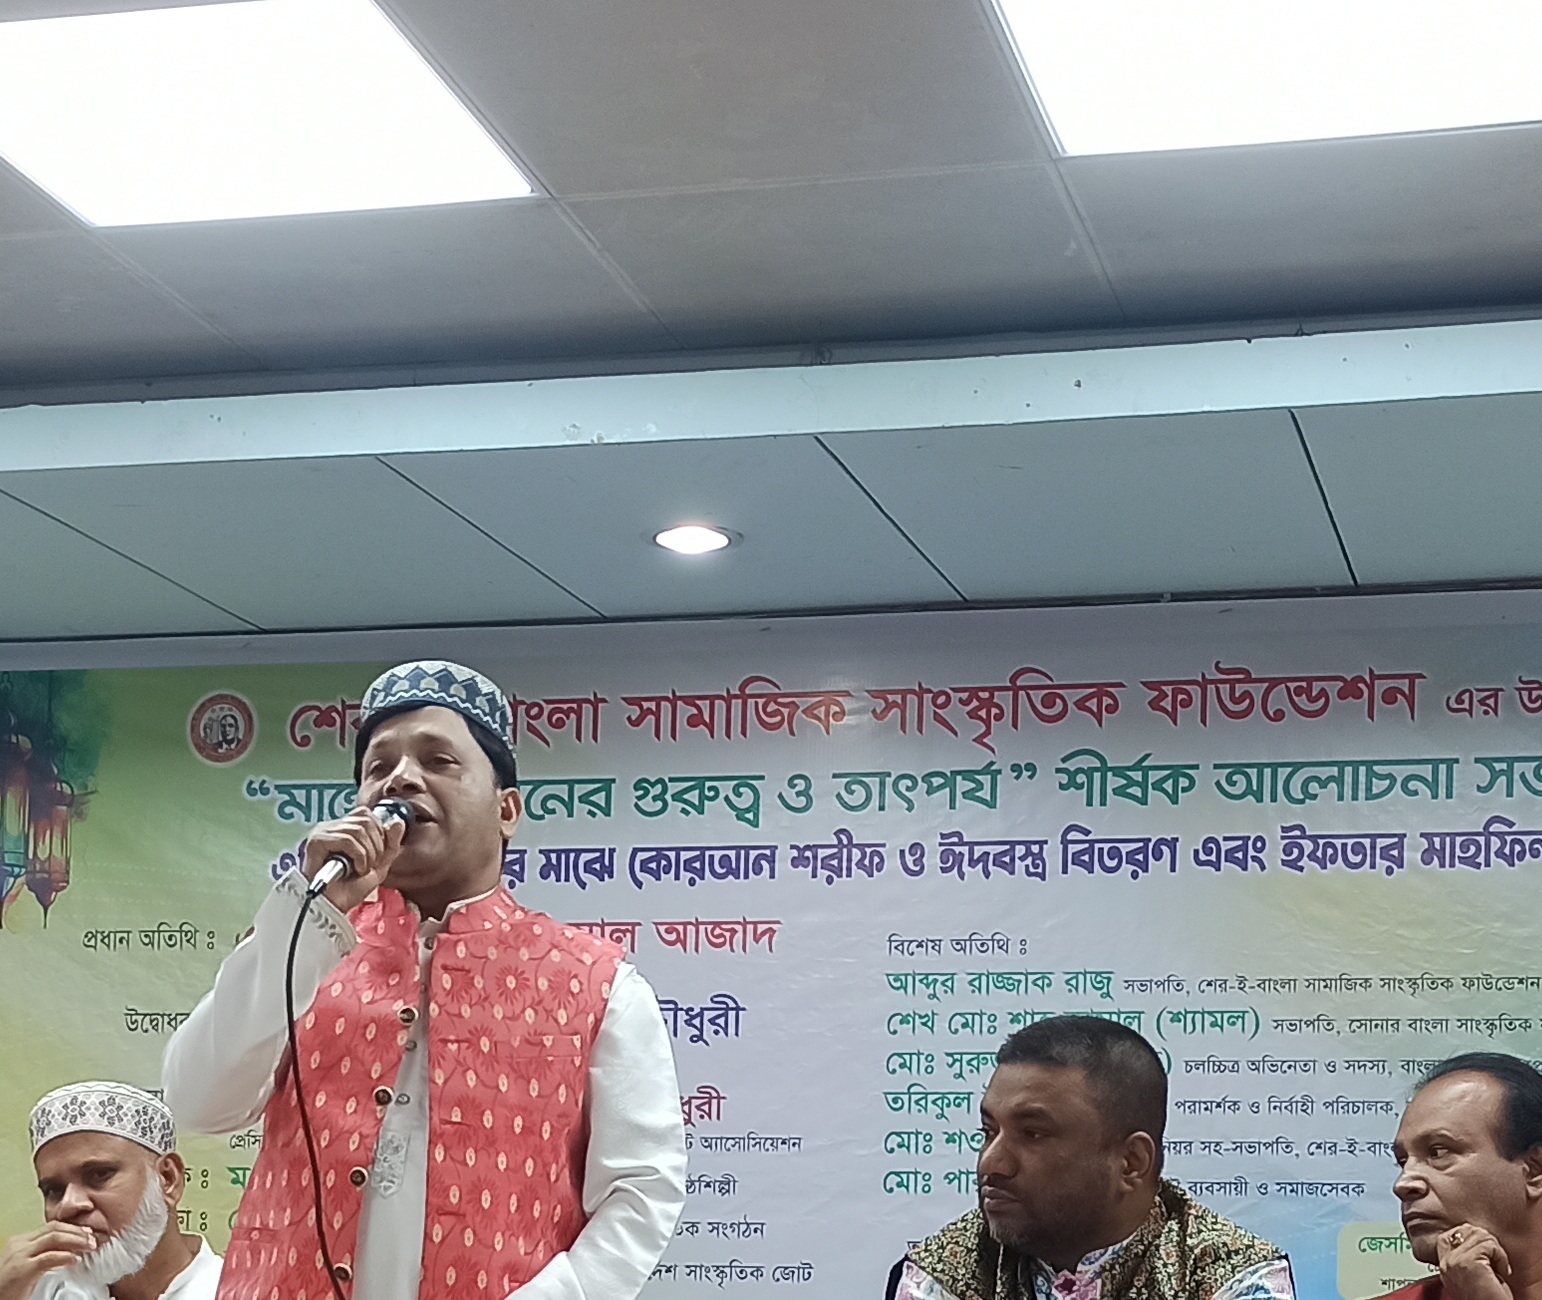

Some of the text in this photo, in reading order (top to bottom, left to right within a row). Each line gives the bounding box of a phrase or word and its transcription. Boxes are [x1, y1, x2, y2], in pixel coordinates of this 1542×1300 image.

[621, 675, 852, 742] সামাজিক
[865, 667, 1126, 754] সাংস্কৃতিক
[1140, 660, 1427, 728] ফাউন্ডেশন
[1445, 687, 1505, 719] এর
[632, 774, 765, 829] গুরুত্ব
[777, 773, 814, 814] ও
[1056, 749, 1200, 809] শীর্ষক
[1213, 757, 1460, 806] আলোচনা
[538, 847, 616, 891] মাঝে
[629, 844, 777, 887] কোরআন
[790, 828, 886, 886] শরীফ
[898, 842, 926, 877] ও
[939, 831, 1048, 882] ঈদবস্ত্র
[1061, 824, 1179, 880] বিতরণ
[1193, 834, 1267, 873] এবং
[1280, 824, 1407, 876] ইফতার
[82, 929, 131, 952] প্রধান
[139, 922, 200, 951] অতিথি
[652, 916, 783, 954] আজাদ
[886, 933, 944, 956] বিশেষ
[950, 932, 1010, 955] অতিথি
[885, 968, 1542, 1003] আব্দুর রাজ্জাক রাজু সভাপতি, শের-ই-বাংলা সামাজিক সাংস্কৃতিক ফাউন্ডেশন
[887, 1009, 939, 1036] শেখ
[948, 1008, 998, 1036] মোঃ
[1156, 1006, 1260, 1041] (শ্যামল)
[1271, 1013, 1341, 1037] সভাপতি,
[1348, 1017, 1401, 1034] সোনার
[1407, 1017, 1451, 1035] বাংলা
[1457, 1012, 1532, 1039] সাংস্কৃতিক
[885, 1048, 935, 1077] মোঃ
[1246, 1055, 1316, 1076] অভিনেতা
[1324, 1059, 1337, 1075] ও
[883, 1082, 975, 1123] তরিকুল
[1174, 1095, 1241, 1116] পরামর্শক
[1248, 1099, 1261, 1116] ও
[1268, 1094, 1316, 1118] নির্বাহী
[700, 1131, 803, 1152] অ্যাসোসিয়েশন
[883, 1128, 933, 1156] মোঃ
[883, 1167, 932, 1195] মোঃ
[1256, 1183, 1269, 1196] ও
[1274, 1181, 1367, 1198] সমাজসেবক
[707, 1214, 766, 1239] সংগঠন
[685, 1258, 766, 1290] সাংস্কৃতিক
[772, 1260, 815, 1283] জোট
